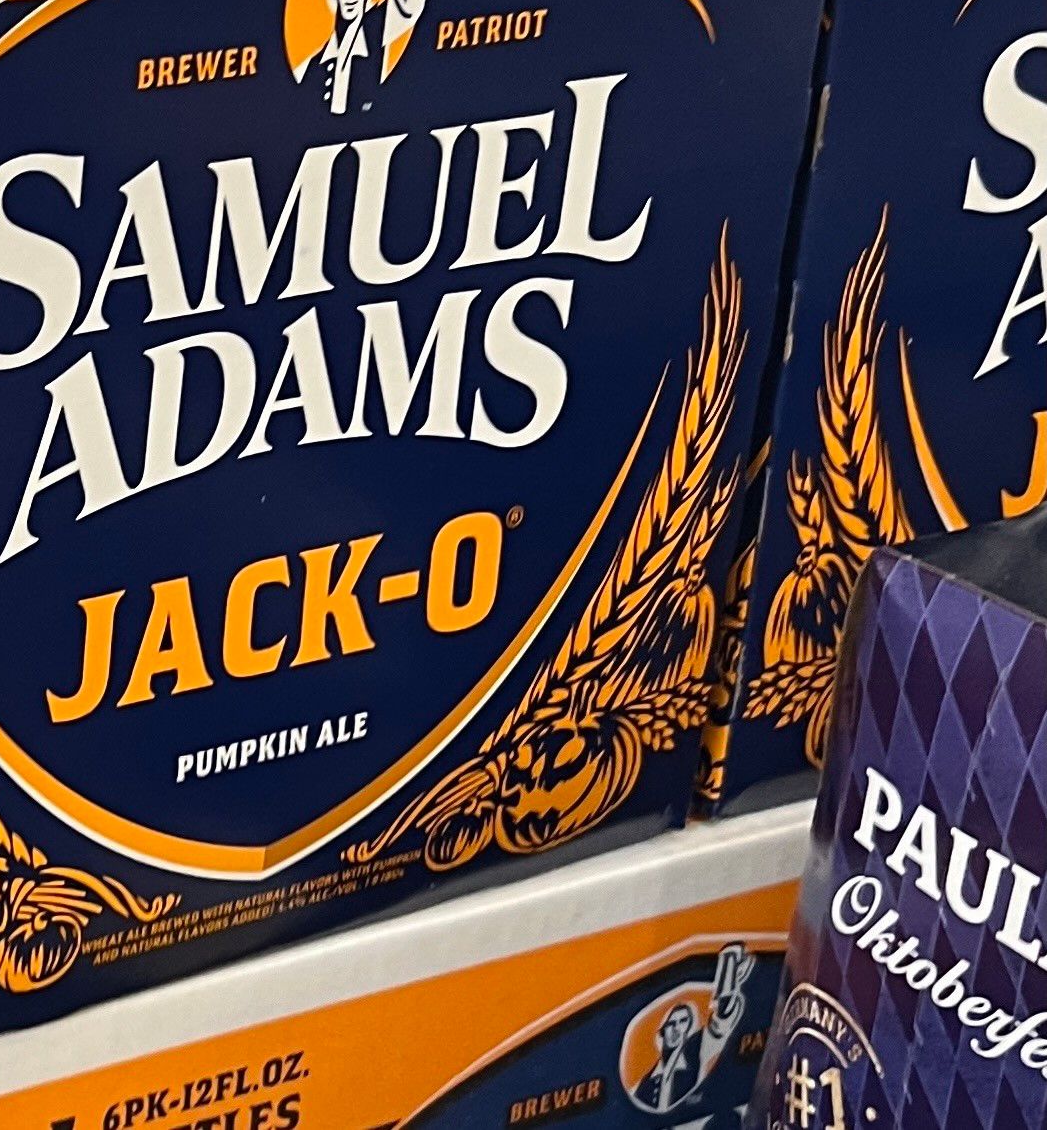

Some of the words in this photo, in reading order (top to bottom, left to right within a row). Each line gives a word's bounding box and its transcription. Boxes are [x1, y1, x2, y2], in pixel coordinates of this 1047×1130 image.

[435, 7, 550, 51] PATRIOT
[136, 45, 259, 91] BREWER
[45, 510, 507, 726] JACK-O
[176, 723, 310, 785] PUMPKIN
[314, 711, 369, 750] ALE
[82, 930, 125, 956] WHEAT
[126, 924, 148, 943] ALE
[151, 909, 201, 937] BREWED
[201, 901, 234, 922] WITH
[235, 885, 287, 913] NATURAL
[289, 870, 340, 897] FLAVORS
[341, 863, 372, 883] WITH
[92, 947, 120, 968] AND
[121, 931, 176, 959] NATURAL
[177, 916, 231, 944] FLAVORS
[510, 1077, 602, 1124] BREWER
